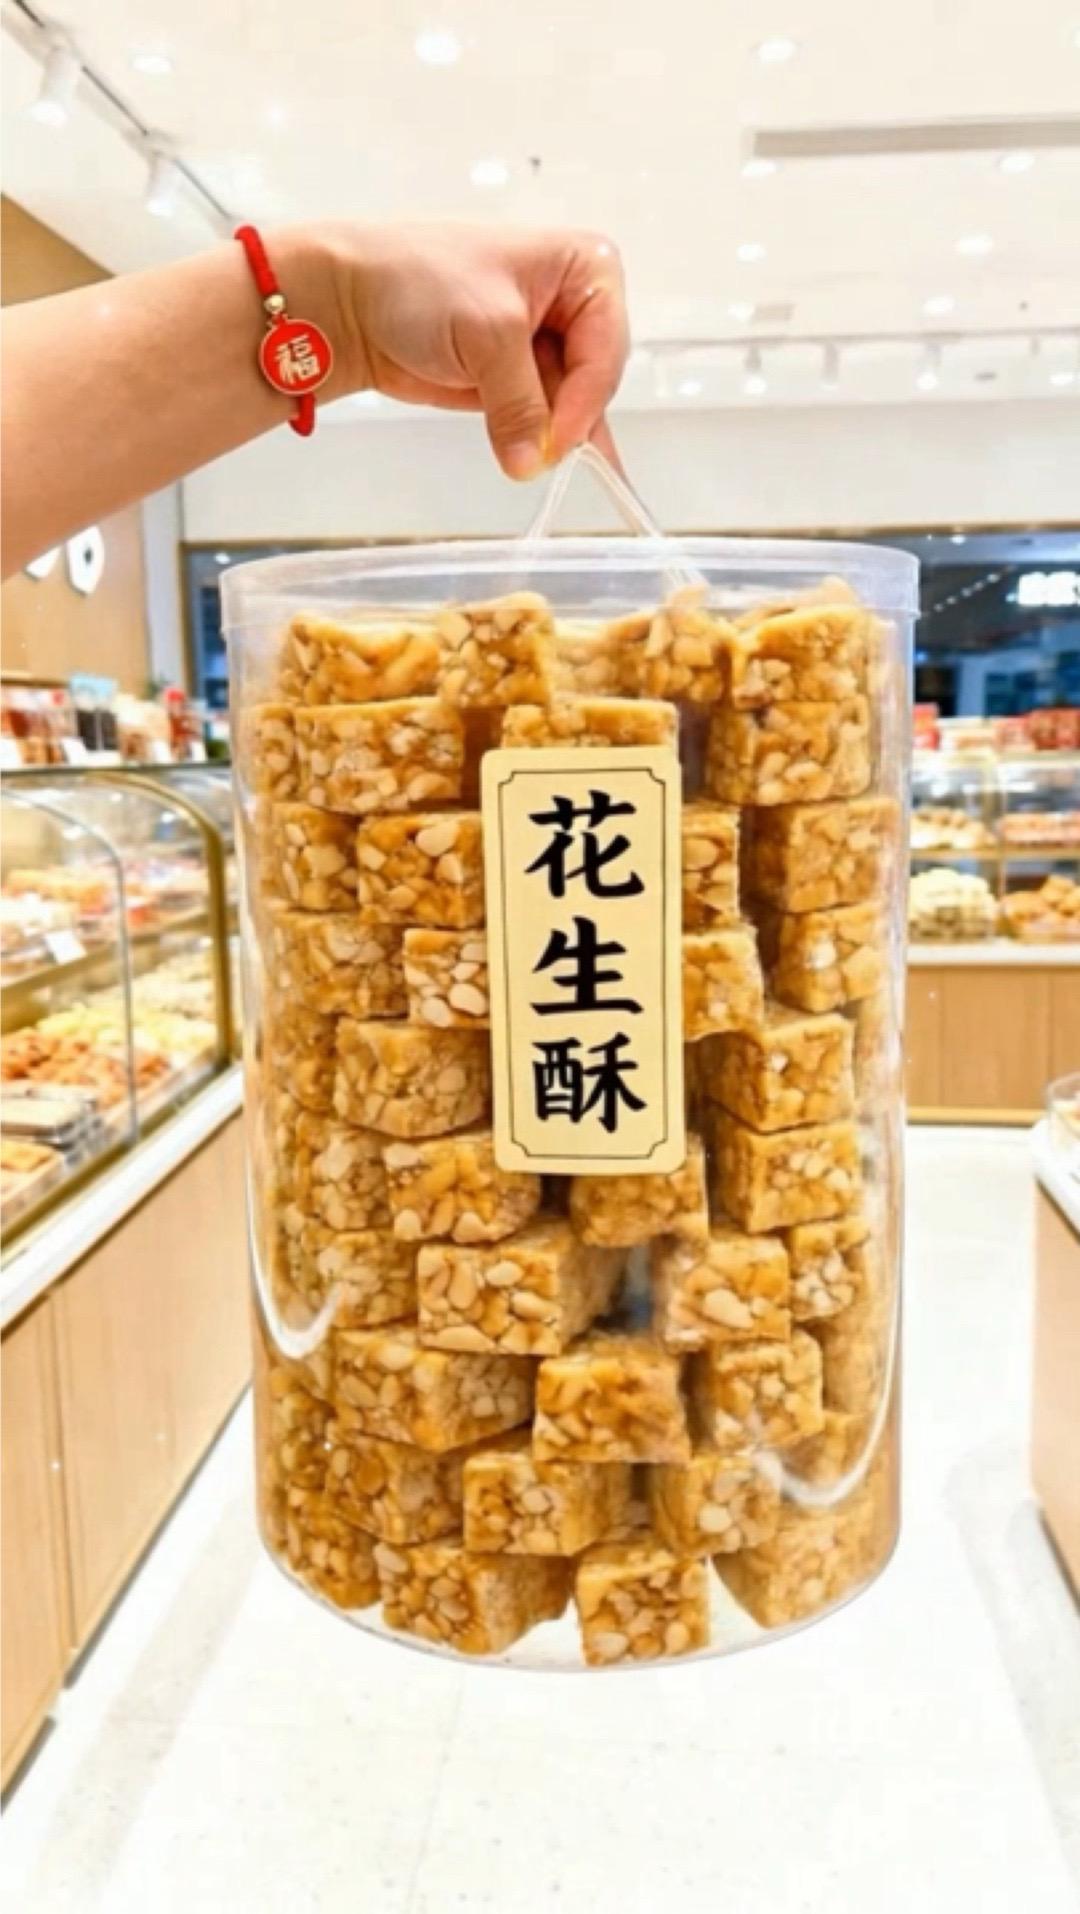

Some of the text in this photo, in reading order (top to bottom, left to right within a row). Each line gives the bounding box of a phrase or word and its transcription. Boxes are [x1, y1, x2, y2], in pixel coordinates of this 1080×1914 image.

[274, 333, 320, 384] 福
[524, 789, 647, 1133] 花生酥
